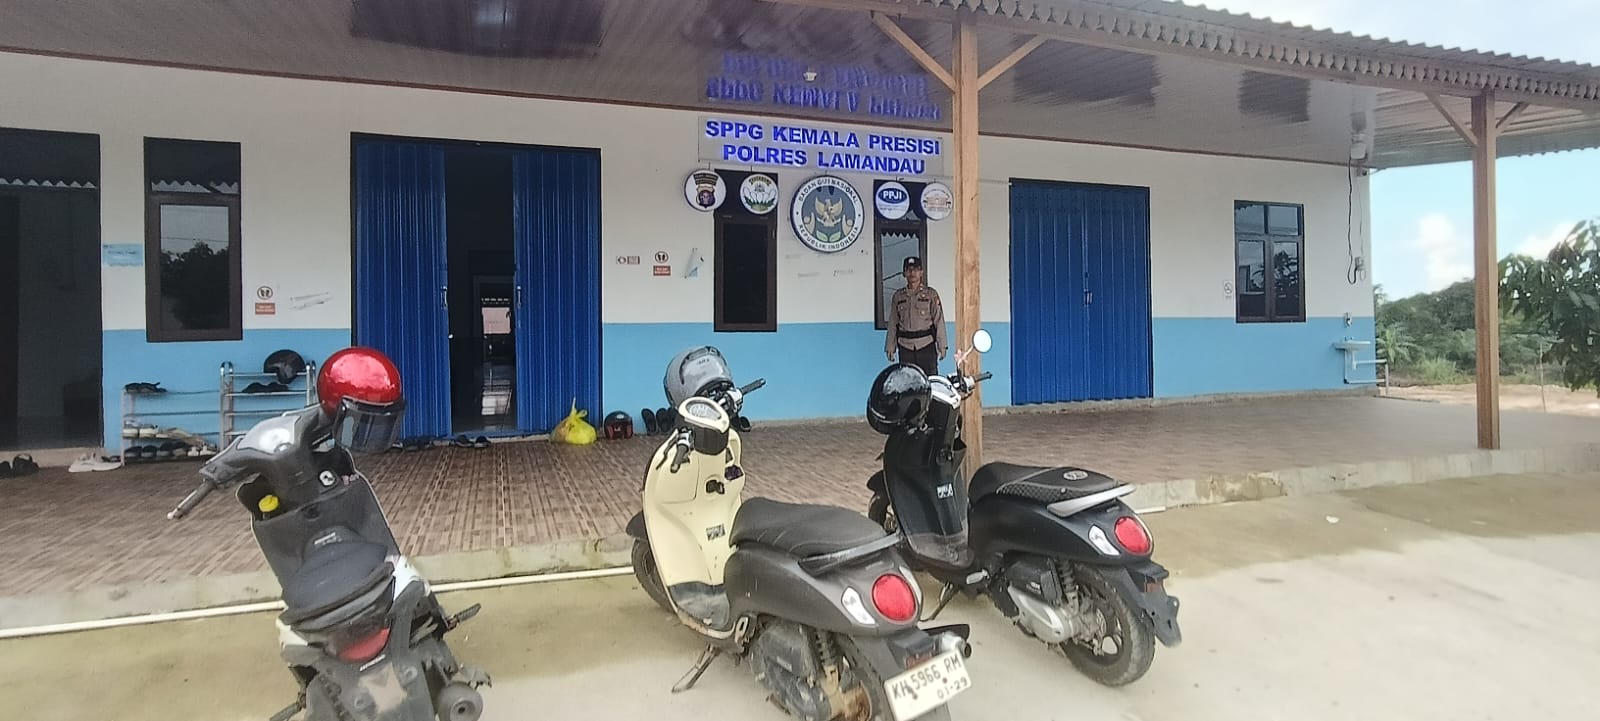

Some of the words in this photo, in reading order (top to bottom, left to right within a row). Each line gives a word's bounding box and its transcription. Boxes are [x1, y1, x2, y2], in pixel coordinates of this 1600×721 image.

[705, 120, 763, 140] SPPG
[773, 125, 860, 148] KEMALA
[868, 134, 940, 155] PRESISI
[723, 144, 807, 165] POLRES
[818, 151, 925, 174] LAMANDAU
[799, 181, 817, 202] BADAN
[831, 179, 859, 204] NASIONAL
[882, 190, 902, 200] PPJI
[828, 226, 859, 249] INDONESIA
[892, 679, 909, 700] KH
[910, 664, 941, 691] 5966
[943, 653, 962, 673] RM
